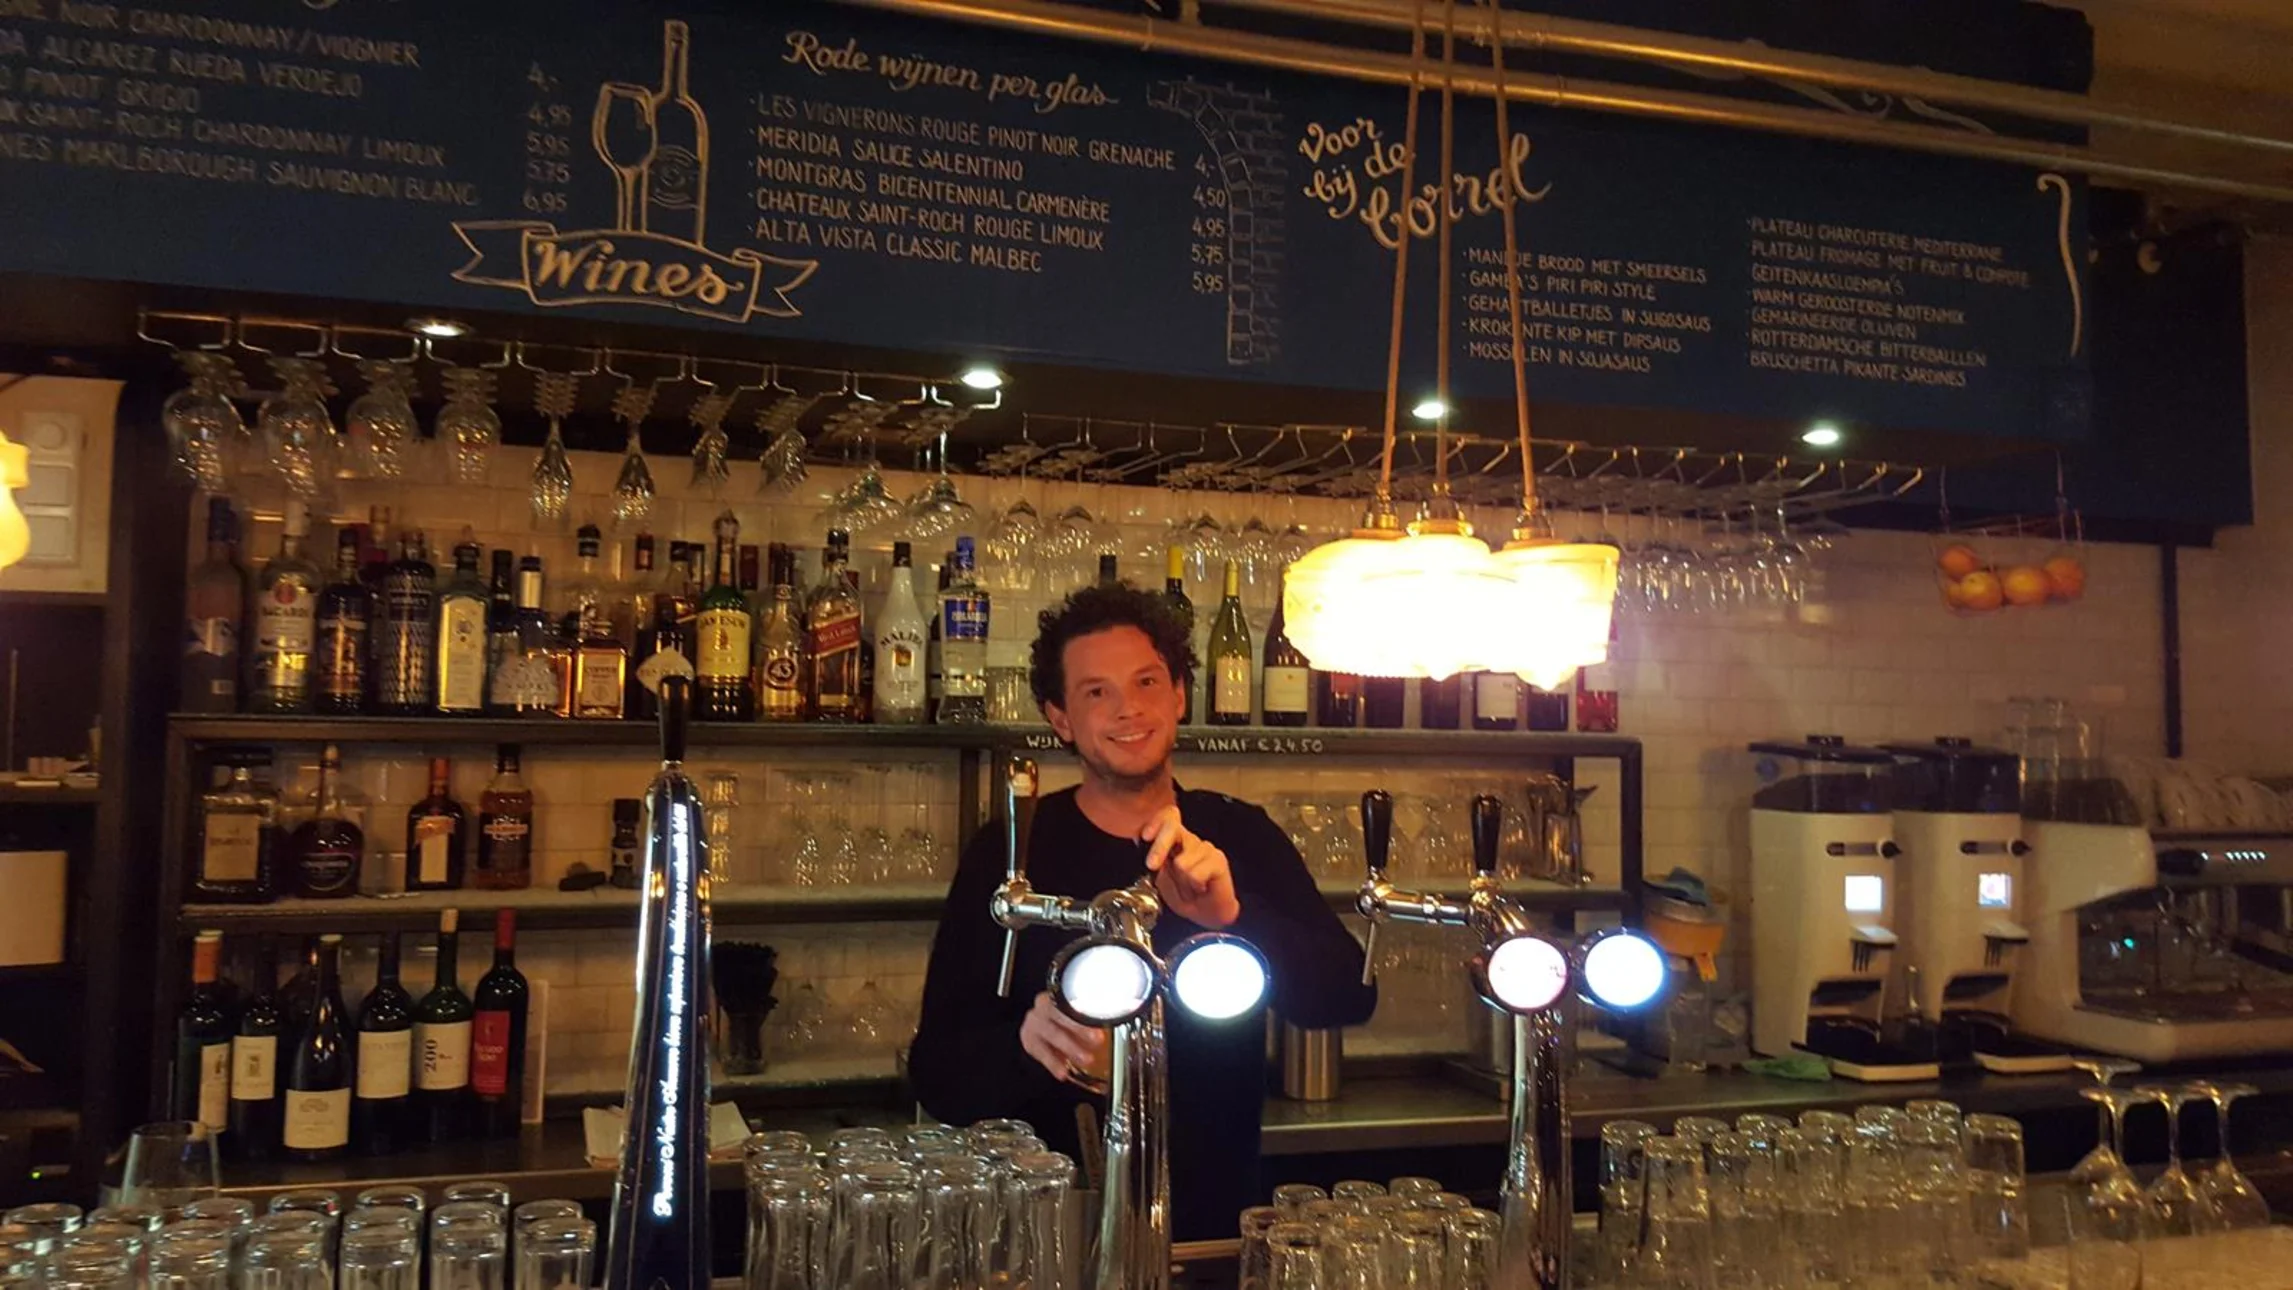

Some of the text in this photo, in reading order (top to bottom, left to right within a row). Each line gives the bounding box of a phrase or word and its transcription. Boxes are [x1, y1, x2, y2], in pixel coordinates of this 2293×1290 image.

[258, 60, 363, 99] VERDEJO
[781, 29, 872, 77] Rode
[988, 72, 1041, 102] per
[1033, 72, 1120, 114] glas
[116, 77, 200, 114] GRIGIO
[192, 117, 352, 157] CHARDONNAY
[362, 135, 447, 169] LIMOUX
[757, 91, 1176, 171] LES VIGNERONS ROUGE PINOT NOIR GRENACHE
[756, 154, 868, 194] MONTGRAS
[877, 171, 1012, 211] BICENTENNIAL
[918, 148, 1024, 181] SALENTINO
[1303, 139, 1417, 219] bij de
[266, 159, 399, 199] SAUVIGNON
[404, 175, 481, 207] BLANC
[756, 187, 1104, 251] CHATEAUX SAINT-ROCH ROUGE LIMOUX
[1751, 216, 1813, 239] PLATEAU
[755, 216, 1042, 273] ALTA VISTA CLASSIC MALBEC
[1469, 247, 1533, 268] MANJE
[1538, 254, 1585, 272] BROOD
[1592, 259, 1621, 274] MET
[1751, 239, 1814, 262] PLATEAU
[532, 238, 745, 305] Wines
[1547, 275, 1576, 294] PIRI
[1581, 279, 1608, 297] PIRI
[1611, 281, 1656, 301] STYLE
[1469, 293, 1613, 322] GEHATBALLETJES
[1621, 307, 1636, 324] IN
[1753, 288, 1794, 304] WARM
[1469, 317, 1681, 353] KROKNTE KIP MET DIPSAUS
[1469, 341, 1552, 363] MOSSLEN
[1558, 349, 1574, 365] IN
[1750, 350, 1839, 376] BRUSCHETTA
[1844, 358, 1898, 382] PIKANTE
[1198, 737, 1250, 752] VANAF
